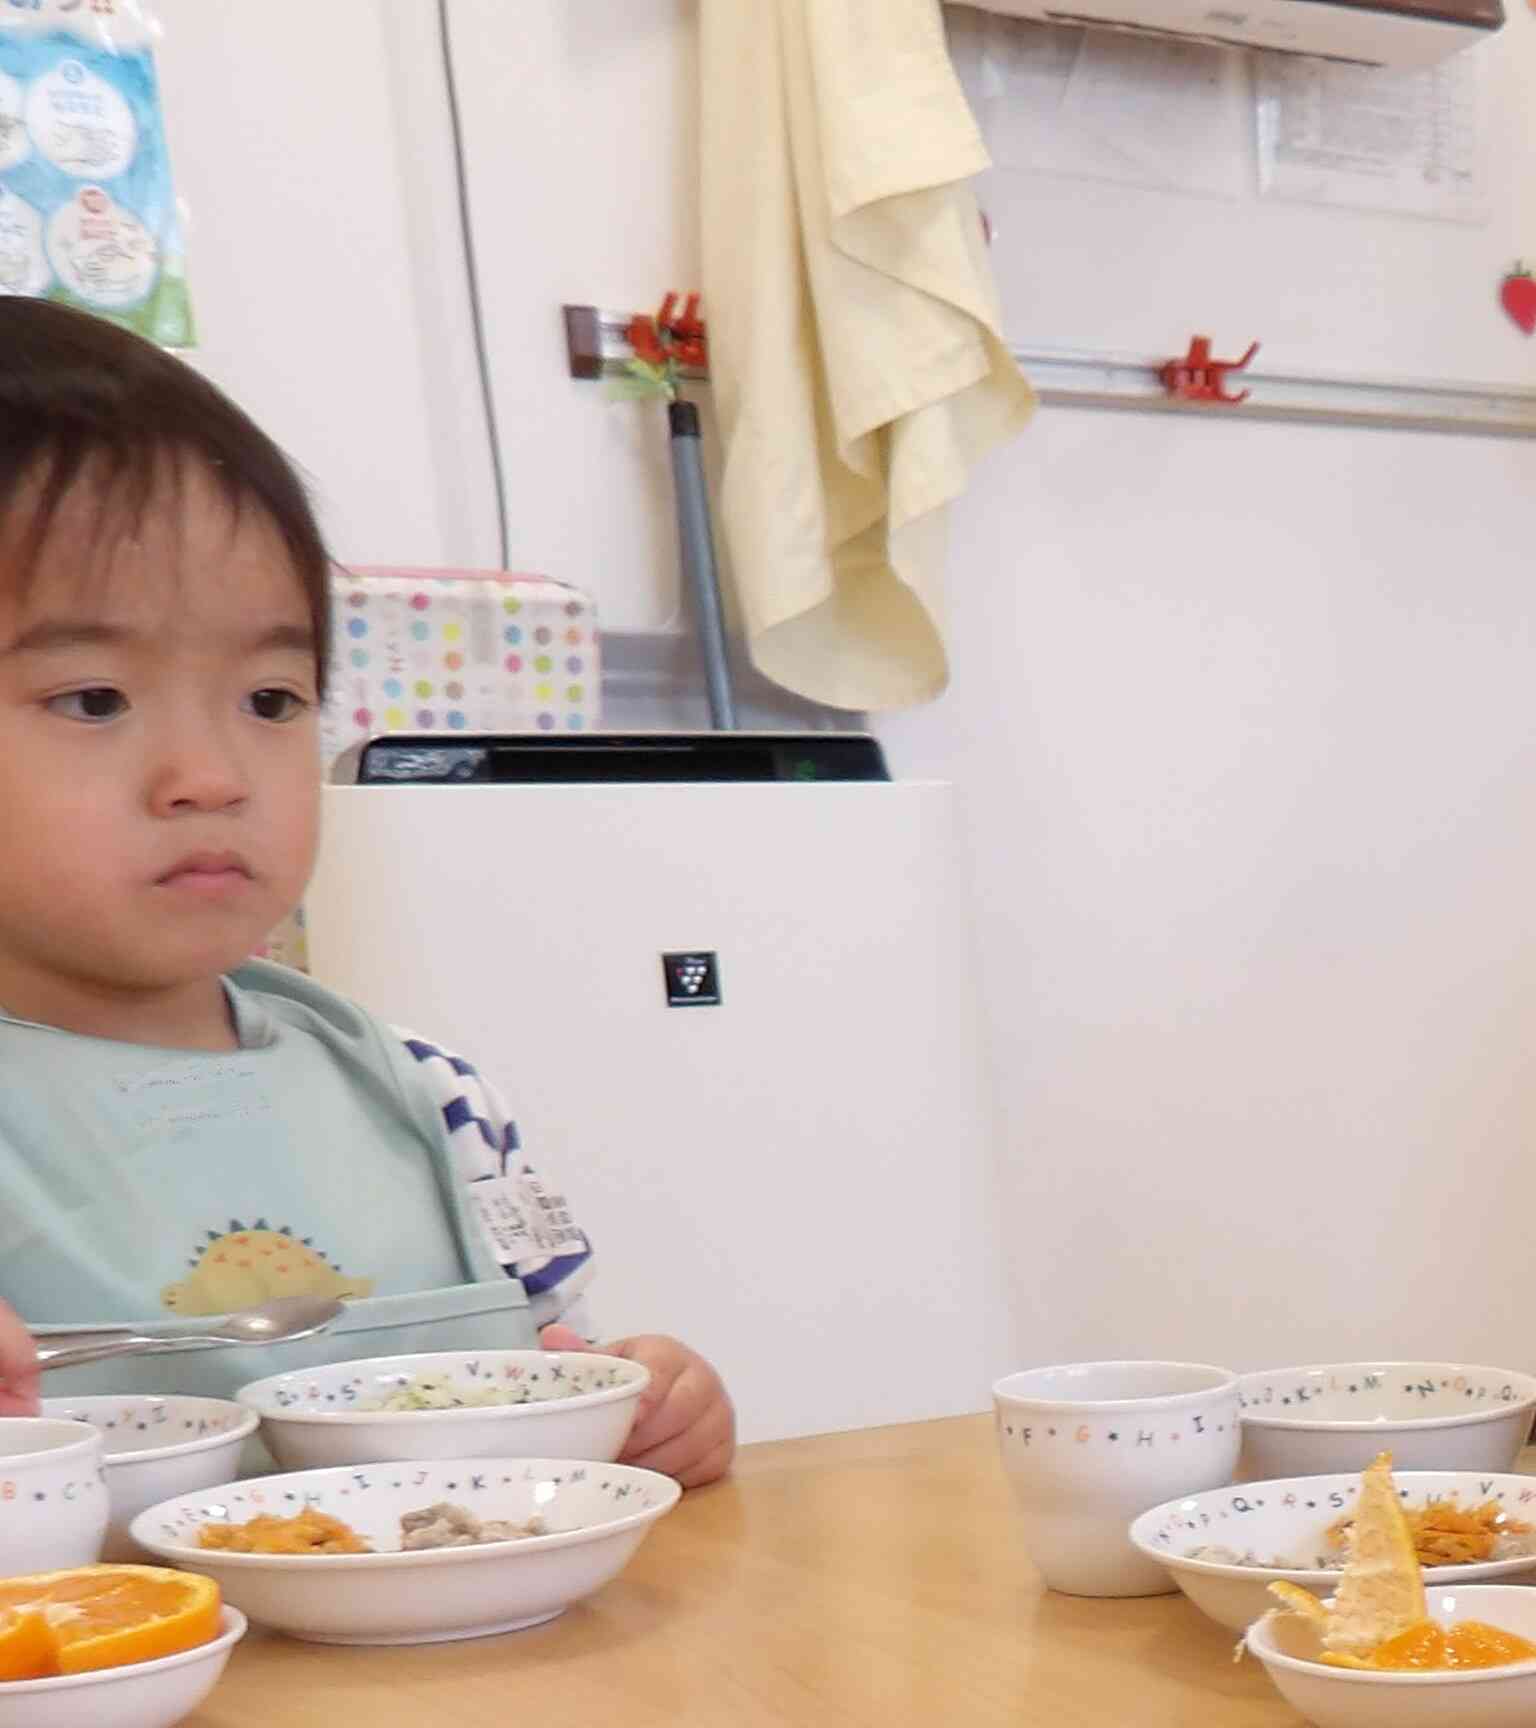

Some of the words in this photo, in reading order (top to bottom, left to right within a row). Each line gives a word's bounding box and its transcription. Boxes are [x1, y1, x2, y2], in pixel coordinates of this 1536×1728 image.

[1231, 1496, 1254, 1513] Q
[1328, 1491, 1345, 1509] S
[1480, 1479, 1495, 1496] V
